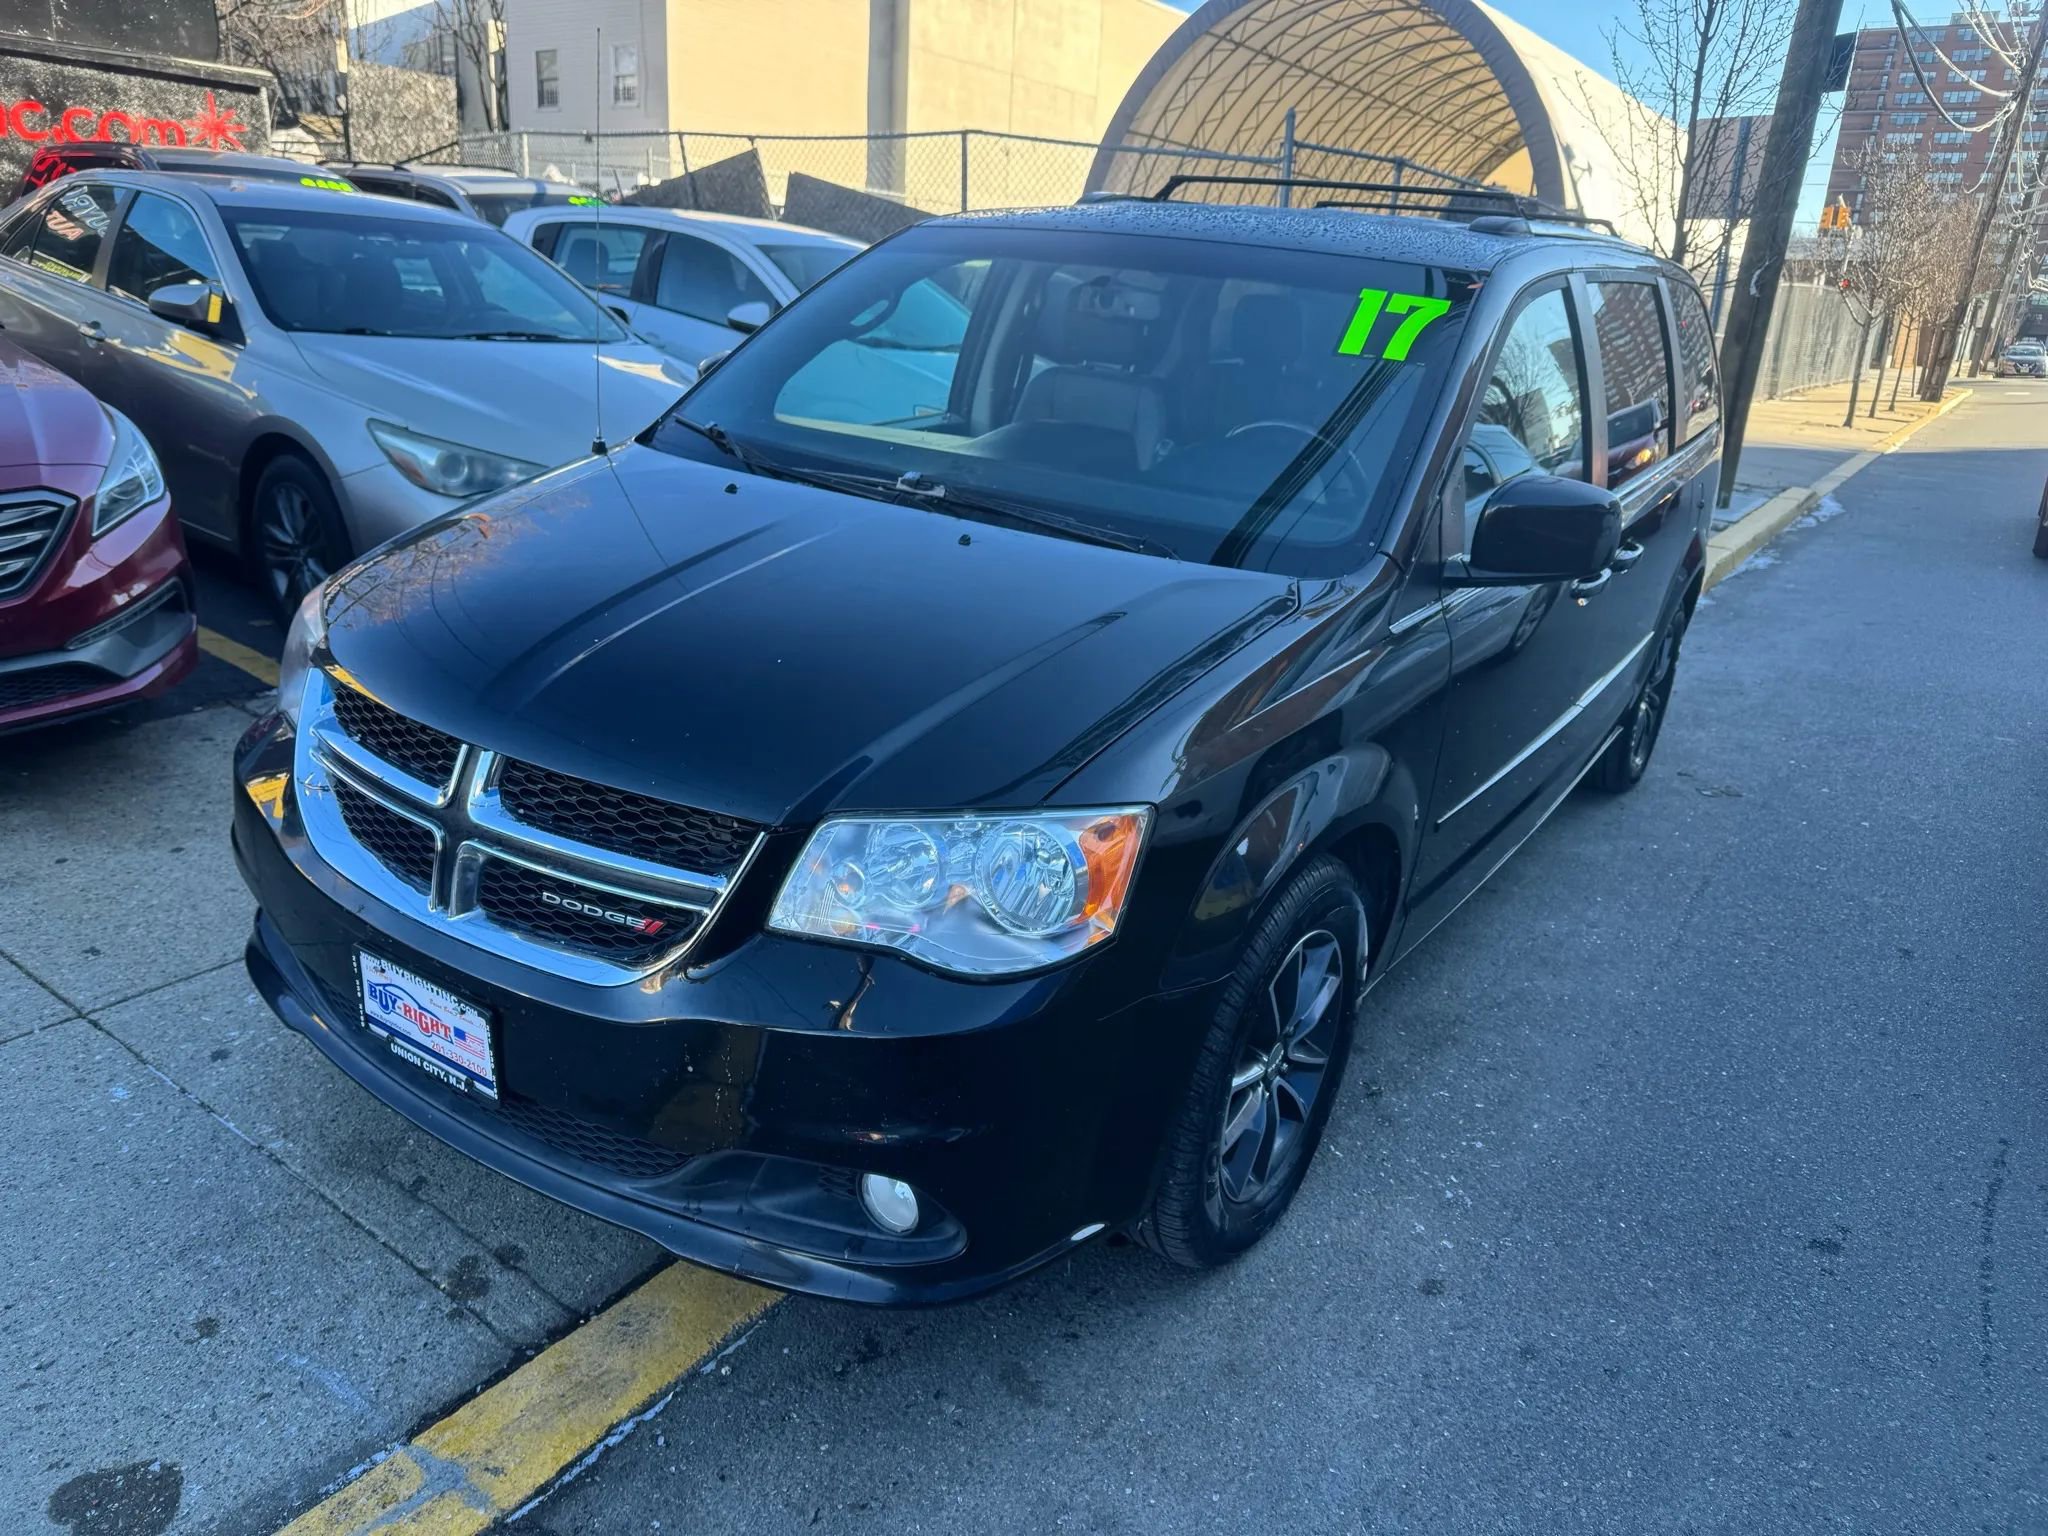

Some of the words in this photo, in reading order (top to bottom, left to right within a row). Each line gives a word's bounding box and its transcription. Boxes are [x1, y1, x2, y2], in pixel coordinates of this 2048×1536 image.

[1338, 288, 1452, 361] 17
[542, 891, 646, 930] DODGE
[390, 1043, 421, 1067] UNION
[423, 1061, 448, 1082] CITY,
[449, 1075, 468, 1092] N.J.
[430, 1041, 487, 1077] 201-330-2100
